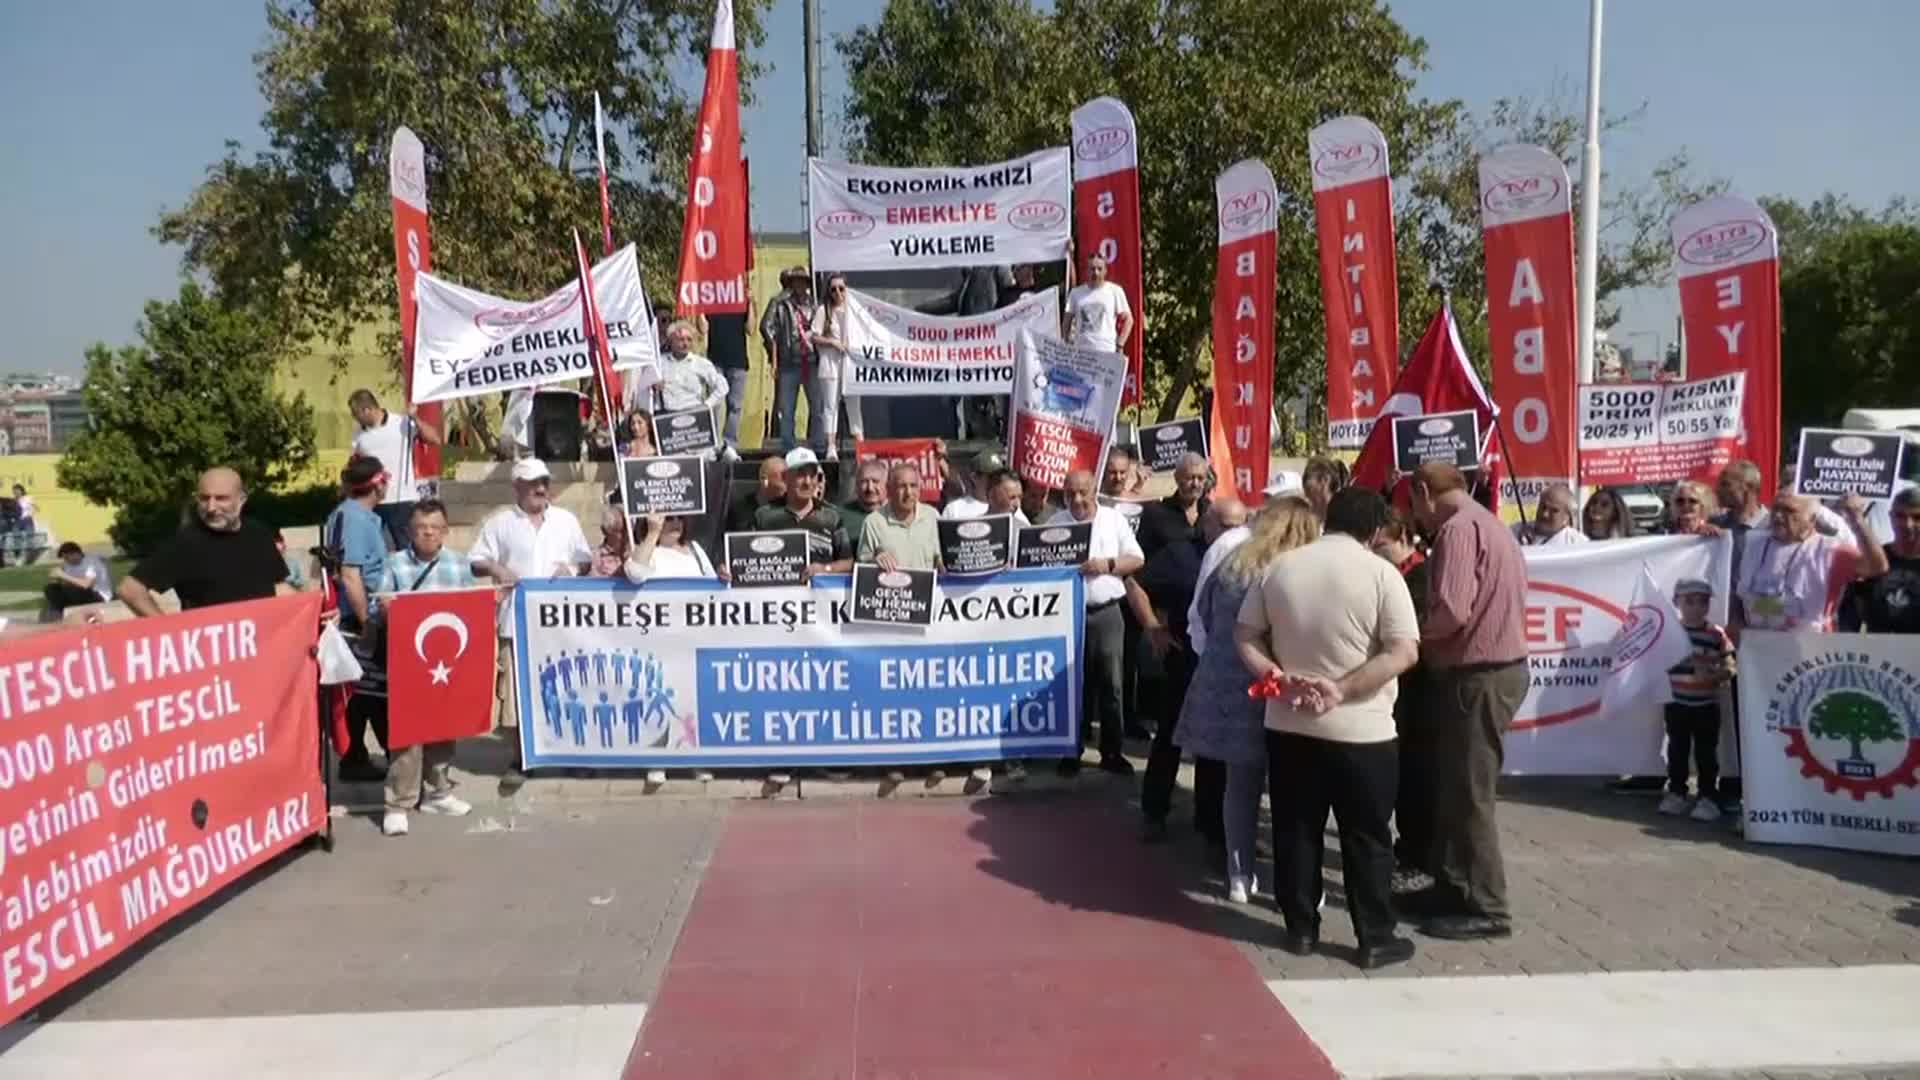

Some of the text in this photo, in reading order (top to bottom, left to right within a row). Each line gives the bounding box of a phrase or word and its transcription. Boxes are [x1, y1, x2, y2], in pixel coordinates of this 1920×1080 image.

[847, 163, 1032, 195] EKONOMİK KRİZİ
[886, 200, 997, 225] EMEKLİYE
[890, 235, 995, 257] YÜKLEME
[680, 274, 744, 305] KISMİ
[484, 343, 504, 359] ve
[511, 320, 633, 354] EMEKLER
[907, 323, 996, 342] 5000 PRİM
[863, 345, 884, 360] VE
[891, 344, 941, 361] KISMİ
[454, 349, 618, 389] FEDERASYO
[855, 364, 1014, 383] HAKKIMIZI İSTİYO
[1590, 391, 1654, 407] 5000
[1034, 420, 1072, 442] TESCİL
[1814, 456, 1885, 471] EMEKLİNİN
[1819, 469, 1878, 482] HAYATINI
[860, 595, 926, 612] İÇİN HEMEN
[875, 588, 912, 602] GEÇİM
[539, 588, 1062, 635] BİRLEŞE BİRLEŞE KACAĞIZ
[875, 608, 910, 622] SEÇİM
[0, 619, 258, 719] TESCİL HAKTIR
[711, 647, 1055, 692] TÜRKİYE EMEKLİLER
[1530, 657, 1613, 669] KILANLAR
[1533, 674, 1599, 687] ASYONU
[713, 711, 750, 742] VE
[935, 692, 1056, 737] BİRLİĞİ
[0, 675, 241, 789] 000 Arası TESCİL
[109, 721, 266, 807] Giderilmesi
[1749, 809, 1920, 834] 2021 TÜM EMEKLİ-SE
[3, 792, 311, 1003] ESCİL MAĞDURLARI
